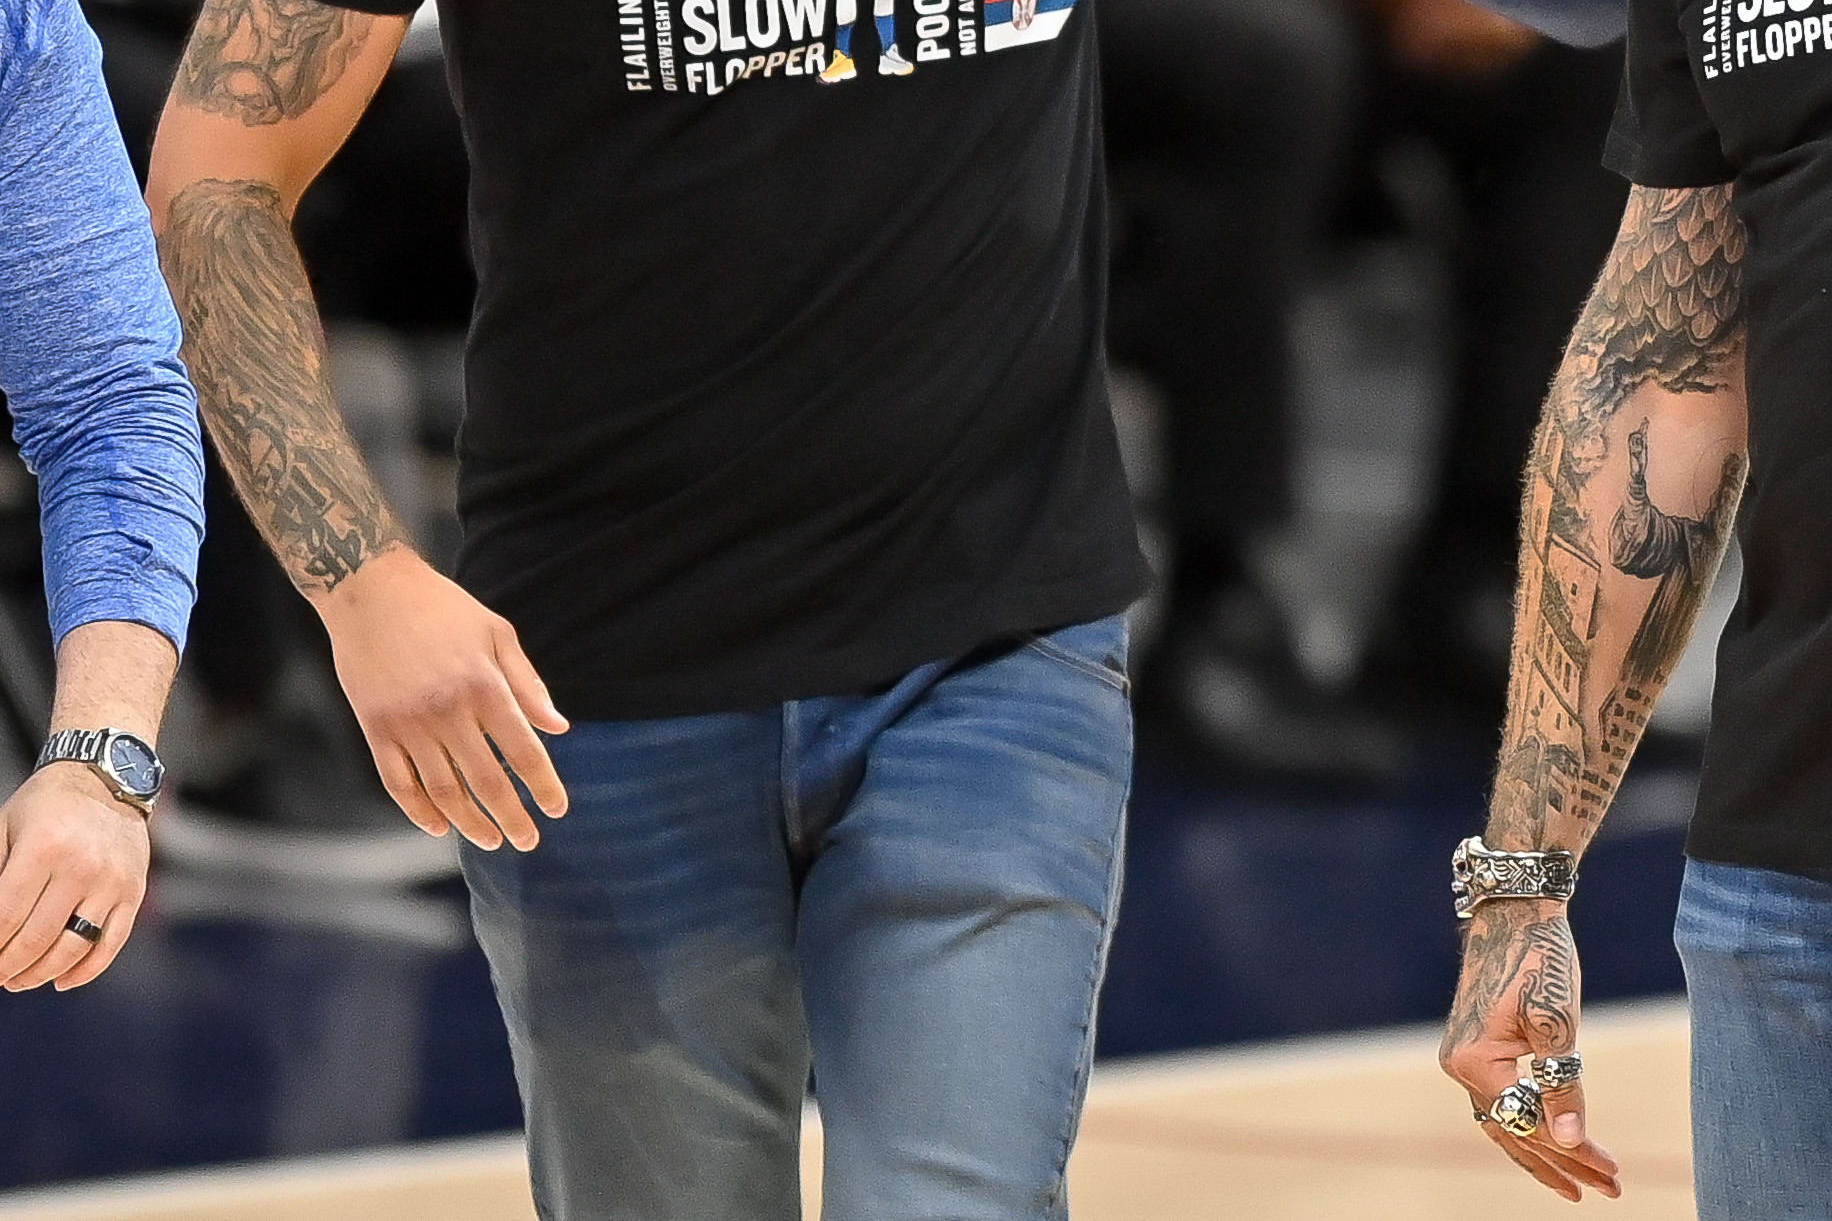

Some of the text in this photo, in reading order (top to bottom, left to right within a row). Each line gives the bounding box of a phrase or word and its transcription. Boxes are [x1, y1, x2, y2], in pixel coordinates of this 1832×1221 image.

[653, 0, 678, 92] OVERWEIGHT
[958, 18, 977, 56] NOT
[685, 42, 826, 96] FLOPPER
